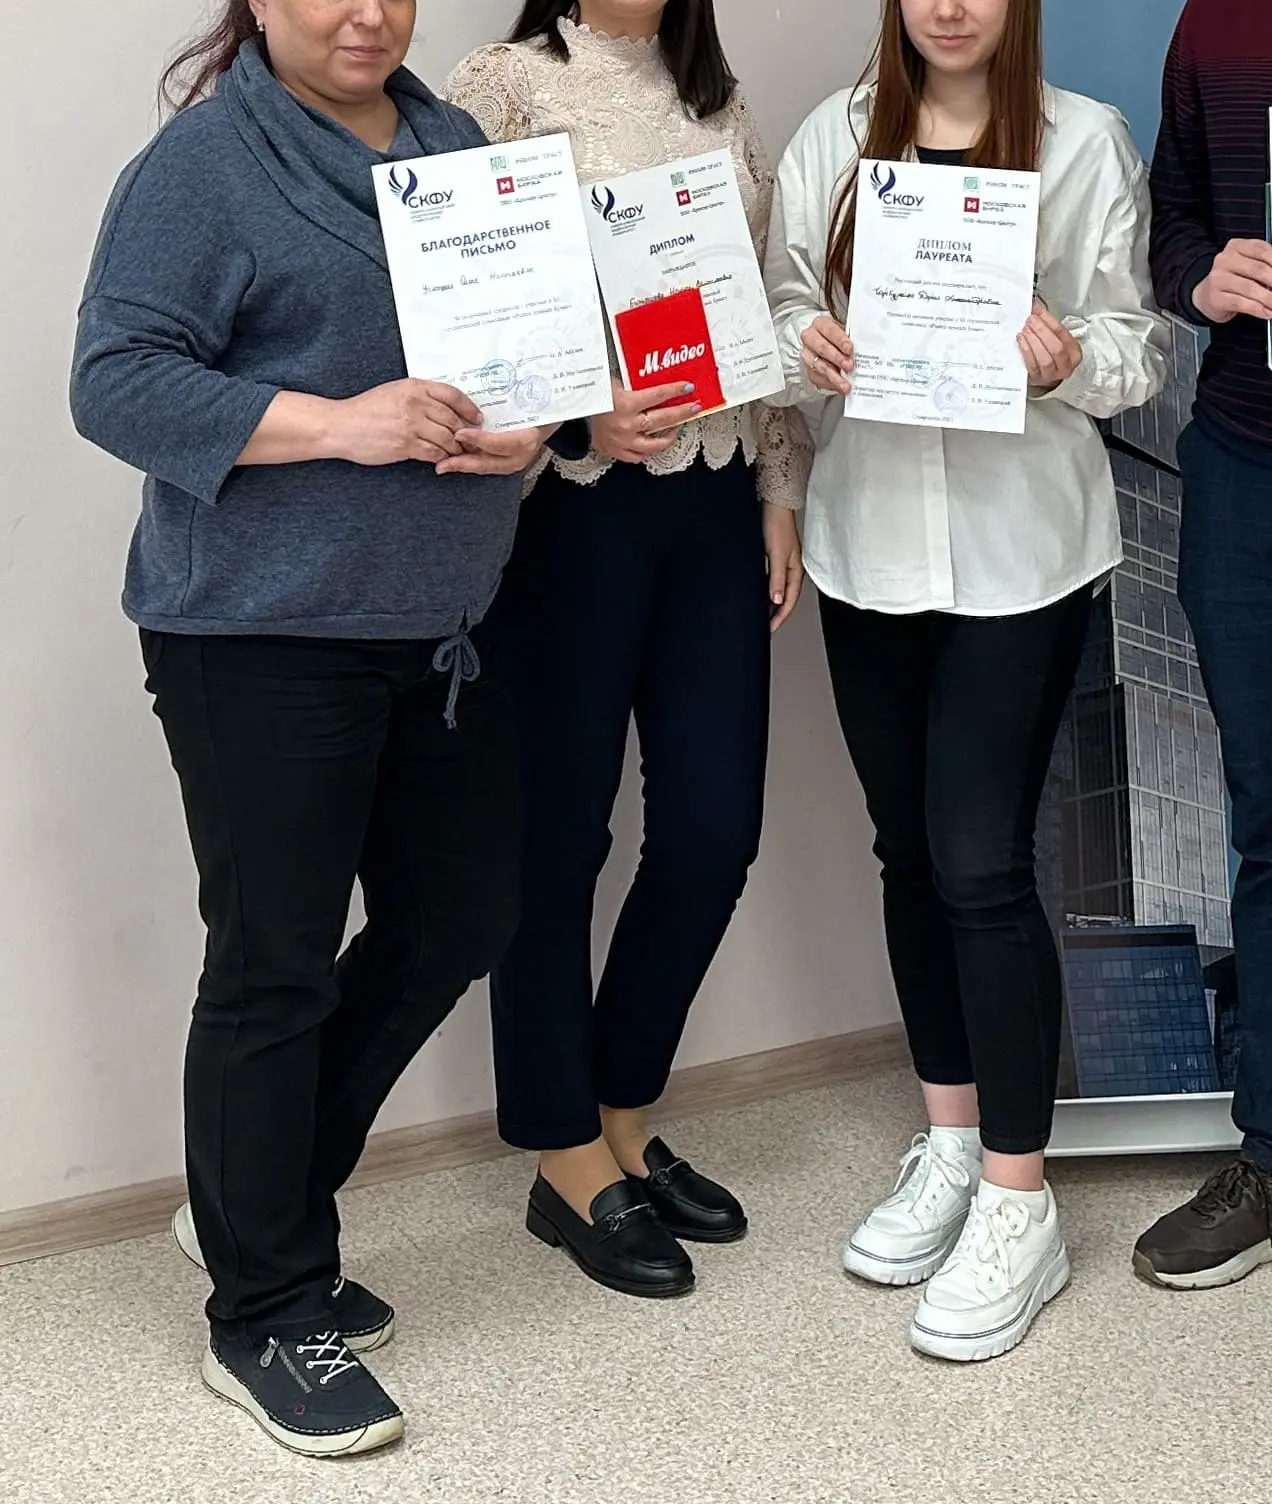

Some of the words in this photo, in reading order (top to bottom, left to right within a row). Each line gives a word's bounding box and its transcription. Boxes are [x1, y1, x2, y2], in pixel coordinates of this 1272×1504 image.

[408, 189, 454, 209] СКФУ
[882, 193, 925, 207] СКФУ
[608, 204, 644, 224] СКФУ
[420, 218, 552, 253] БЛАГОДАРСТВЕННОЕ
[649, 233, 695, 256] ДИПЛОМ
[916, 238, 972, 252] ДИПЛОМ
[460, 239, 517, 260] ПИСЬМО
[915, 250, 973, 264] ЛАУРЕАТА
[638, 343, 705, 377] М.видео
